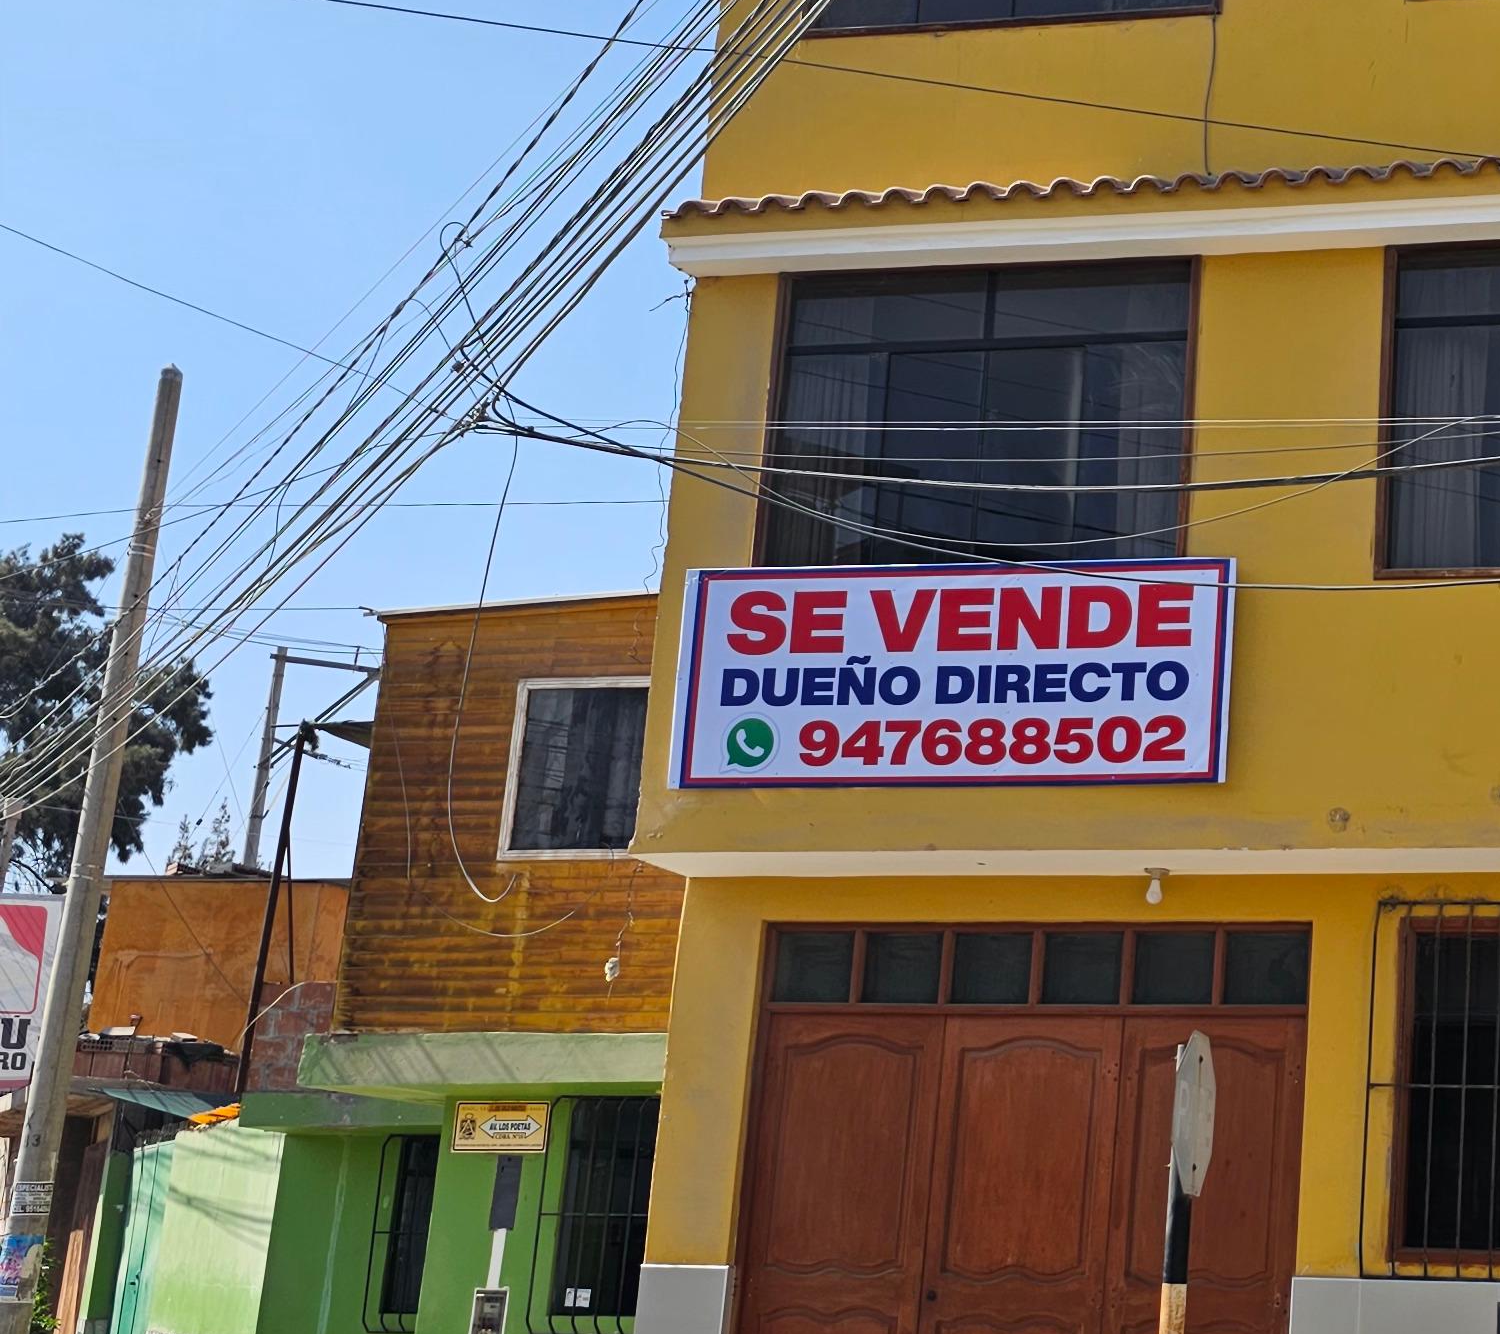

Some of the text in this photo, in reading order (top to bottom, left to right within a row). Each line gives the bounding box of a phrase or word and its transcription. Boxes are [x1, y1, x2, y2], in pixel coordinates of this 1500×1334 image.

[726, 585, 1195, 655] SE VENDE
[720, 655, 1190, 707] DUEÑO DIRECTO
[799, 715, 1187, 767] 947688502
[499, 1123, 509, 1131] LOS
[510, 1123, 531, 1131] POETAS
